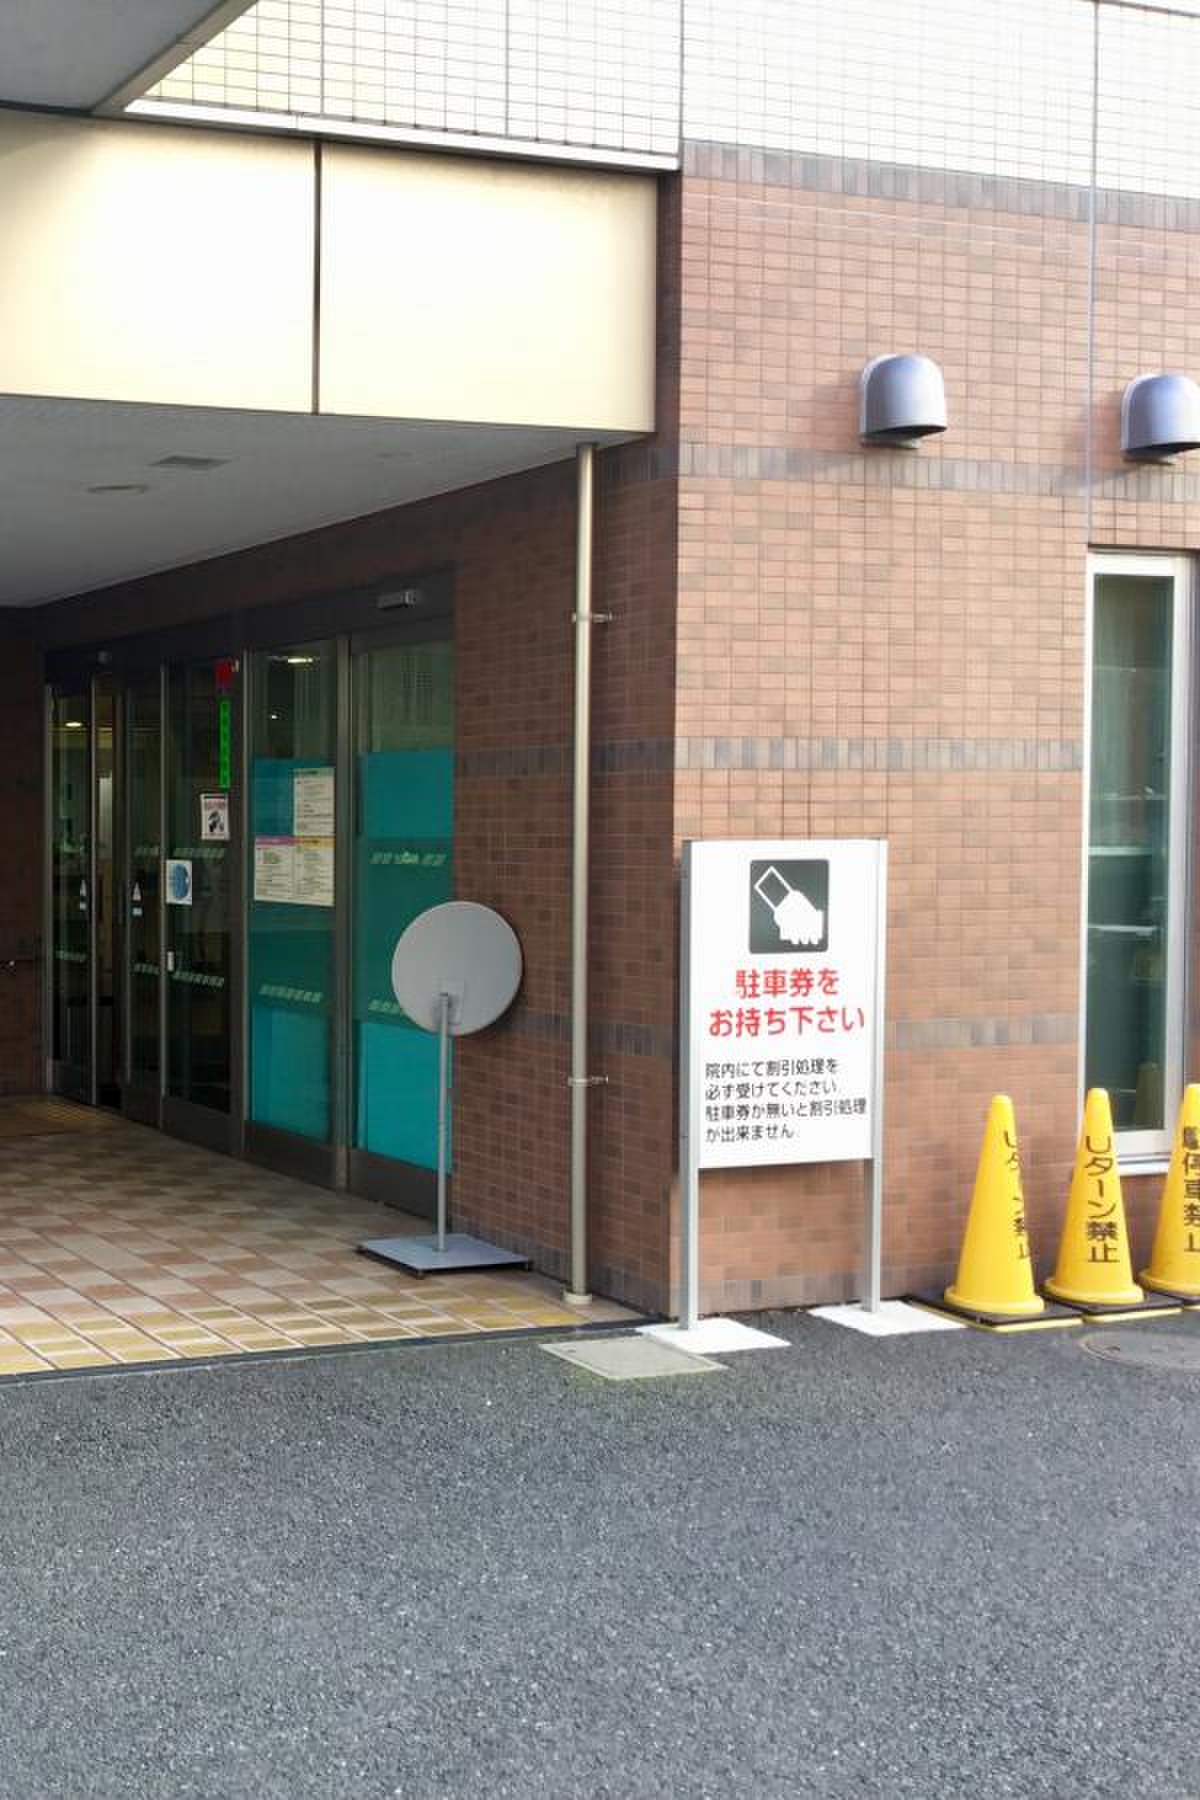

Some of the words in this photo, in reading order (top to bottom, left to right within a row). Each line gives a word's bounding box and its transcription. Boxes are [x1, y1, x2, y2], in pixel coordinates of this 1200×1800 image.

[736, 968, 839, 999] 駐車券を
[709, 1006, 865, 1037] お持ち下さい
[705, 1058, 838, 1080] 院内にて割引処理を
[705, 1097, 867, 1122] 駐車券が無いと割引処理
[1084, 1135, 1120, 1263] Uターン禁止
